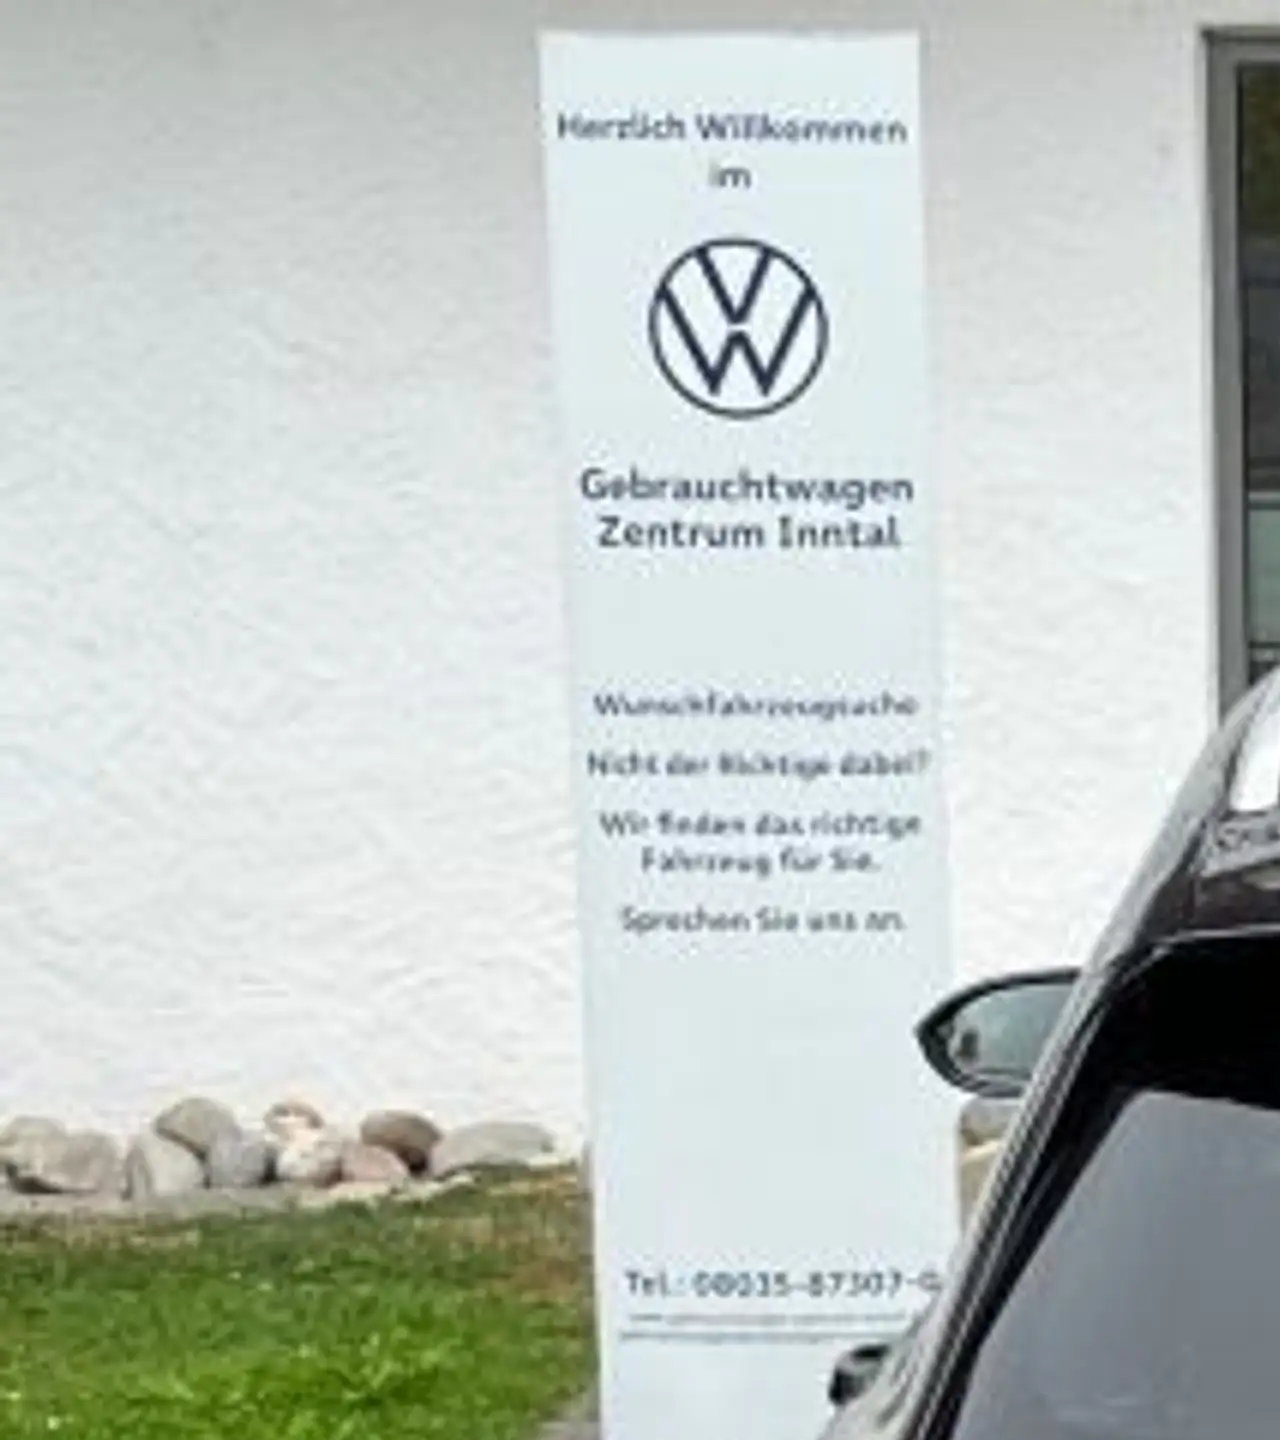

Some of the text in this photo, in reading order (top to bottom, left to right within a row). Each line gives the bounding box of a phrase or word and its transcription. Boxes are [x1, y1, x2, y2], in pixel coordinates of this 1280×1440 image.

[557, 112, 908, 145] Herzlich Willkommen
[709, 160, 752, 189] im
[579, 465, 915, 510] Gebrauchtwagen
[597, 513, 901, 549] Zentrum Inntal
[586, 747, 933, 783] Nicht der Richtige dabei?
[598, 811, 922, 842] Wir finden das richtige
[640, 846, 772, 879] Fahrzeug
[779, 846, 823, 873] für
[619, 905, 752, 936] Sprechen
[754, 905, 800, 932] Sie
[805, 909, 859, 932] uns
